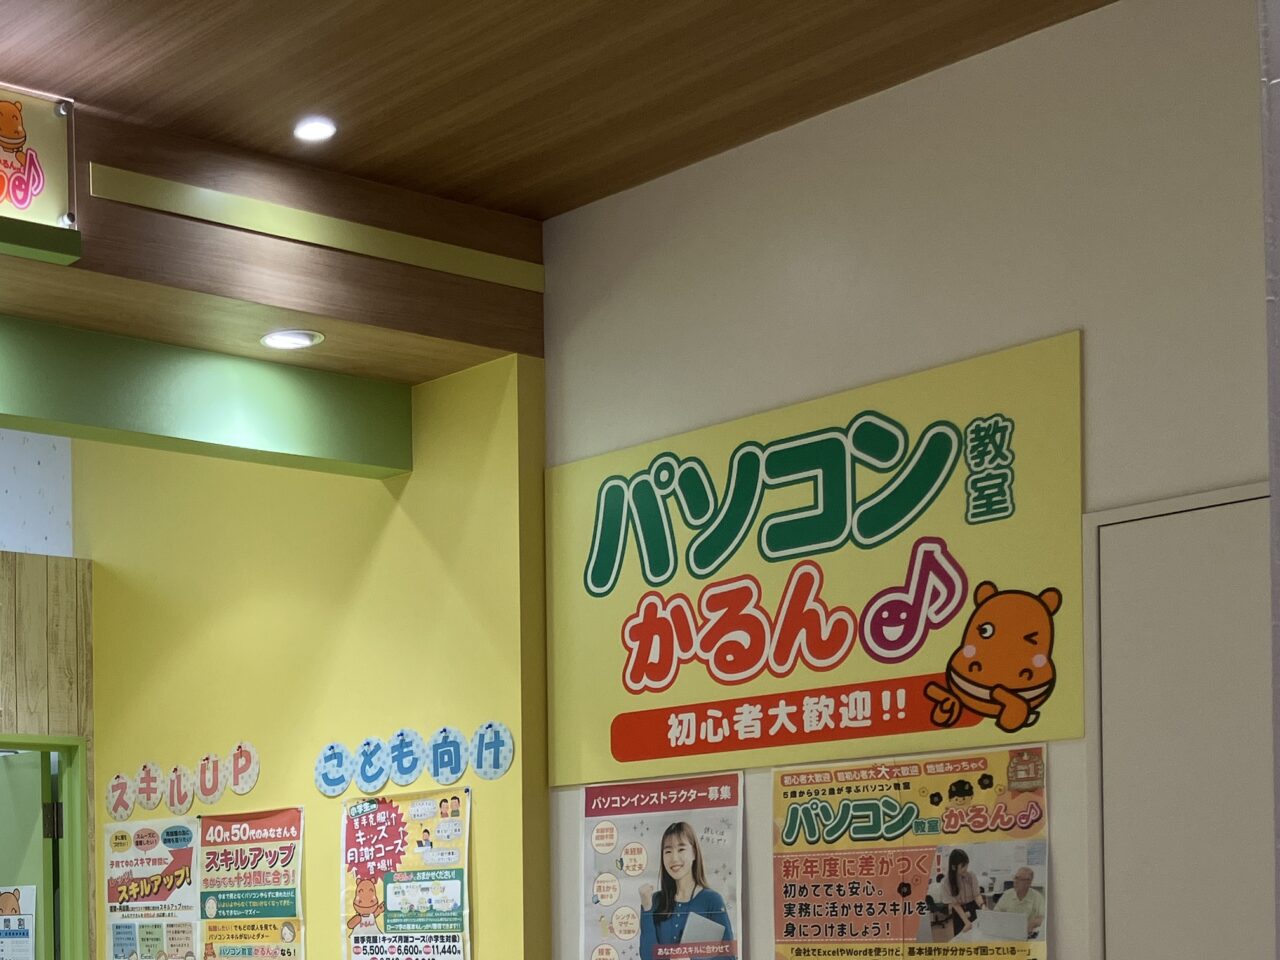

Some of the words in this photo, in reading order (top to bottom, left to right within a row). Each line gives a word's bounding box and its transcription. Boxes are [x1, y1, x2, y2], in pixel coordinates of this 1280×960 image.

[585, 411, 961, 597] パソコン
[964, 414, 1015, 525] 教室
[621, 560, 855, 694] かるん
[666, 689, 907, 748] 初心者大歓迎!!
[322, 730, 505, 787] こども向け
[111, 748, 252, 813] スキルUP
[591, 786, 731, 810] パソコンインストラクター募集
[782, 795, 919, 846] パソコン
[913, 820, 942, 834] 教室
[942, 801, 1014, 834] かるん
[356, 825, 388, 845] キッズ
[205, 843, 295, 872] スキルアップ
[347, 840, 404, 863] 月謝コース
[782, 853, 943, 880] 新年度に差がつく!
[783, 881, 885, 899] 初めてでも安心。
[783, 901, 928, 917] 実務に活かせるスキルを
[783, 922, 892, 938] 身につけましょう!
[657, 944, 730, 956] あなたのスキルに合わせて
